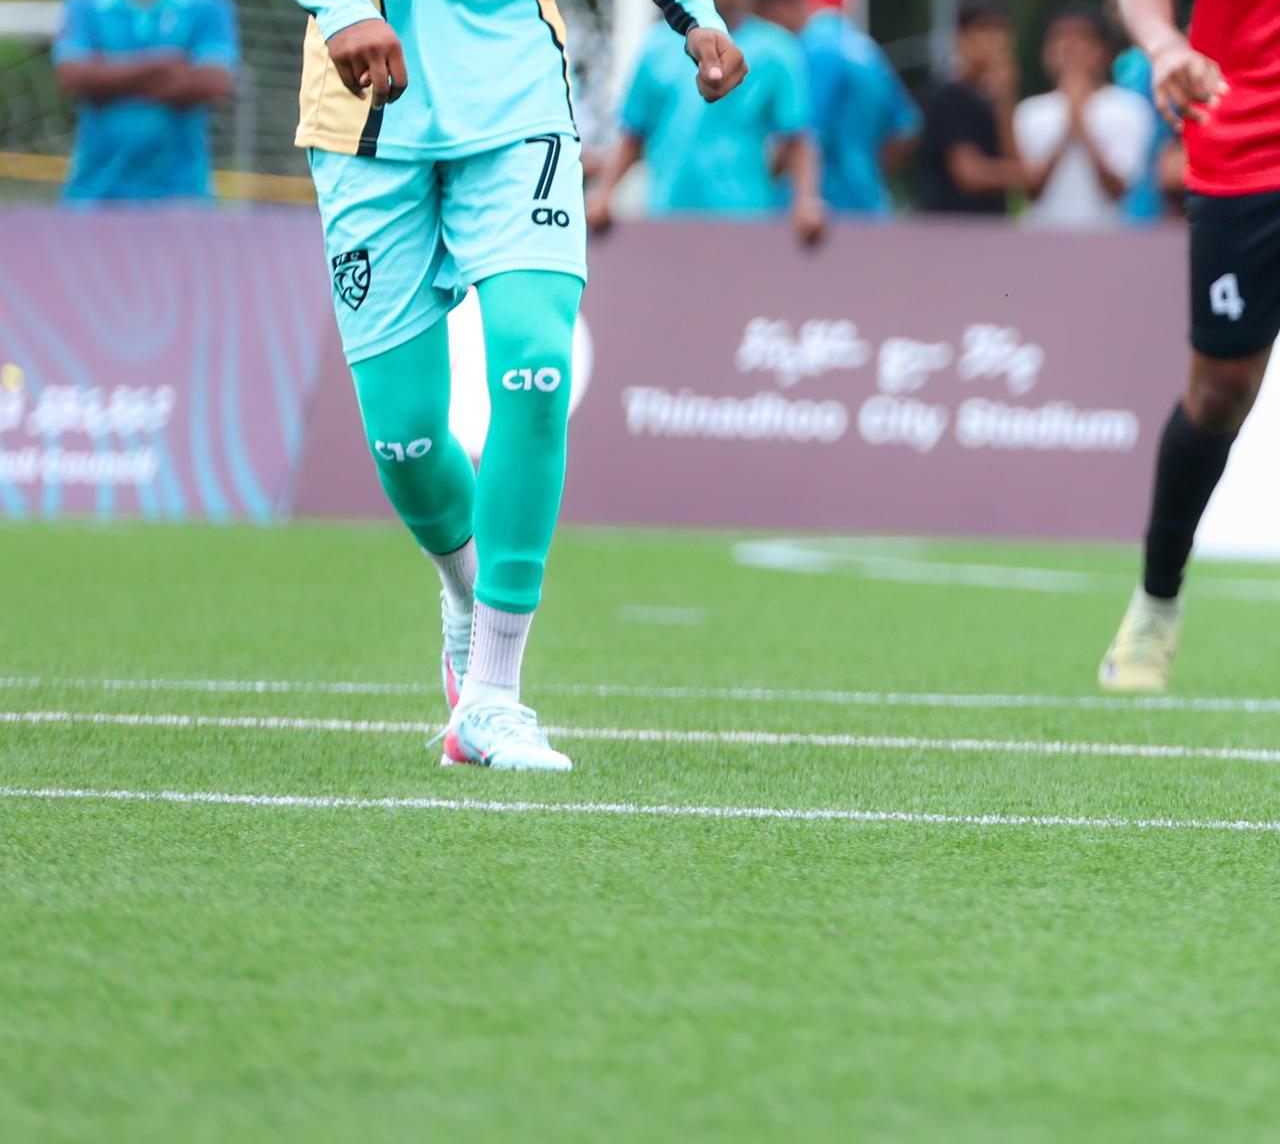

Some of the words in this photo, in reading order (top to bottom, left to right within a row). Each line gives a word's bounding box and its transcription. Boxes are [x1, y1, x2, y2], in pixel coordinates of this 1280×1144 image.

[525, 133, 561, 200] 7
[1209, 272, 1246, 322] 4
[857, 394, 950, 454] City
[954, 396, 1140, 452] Stadium
